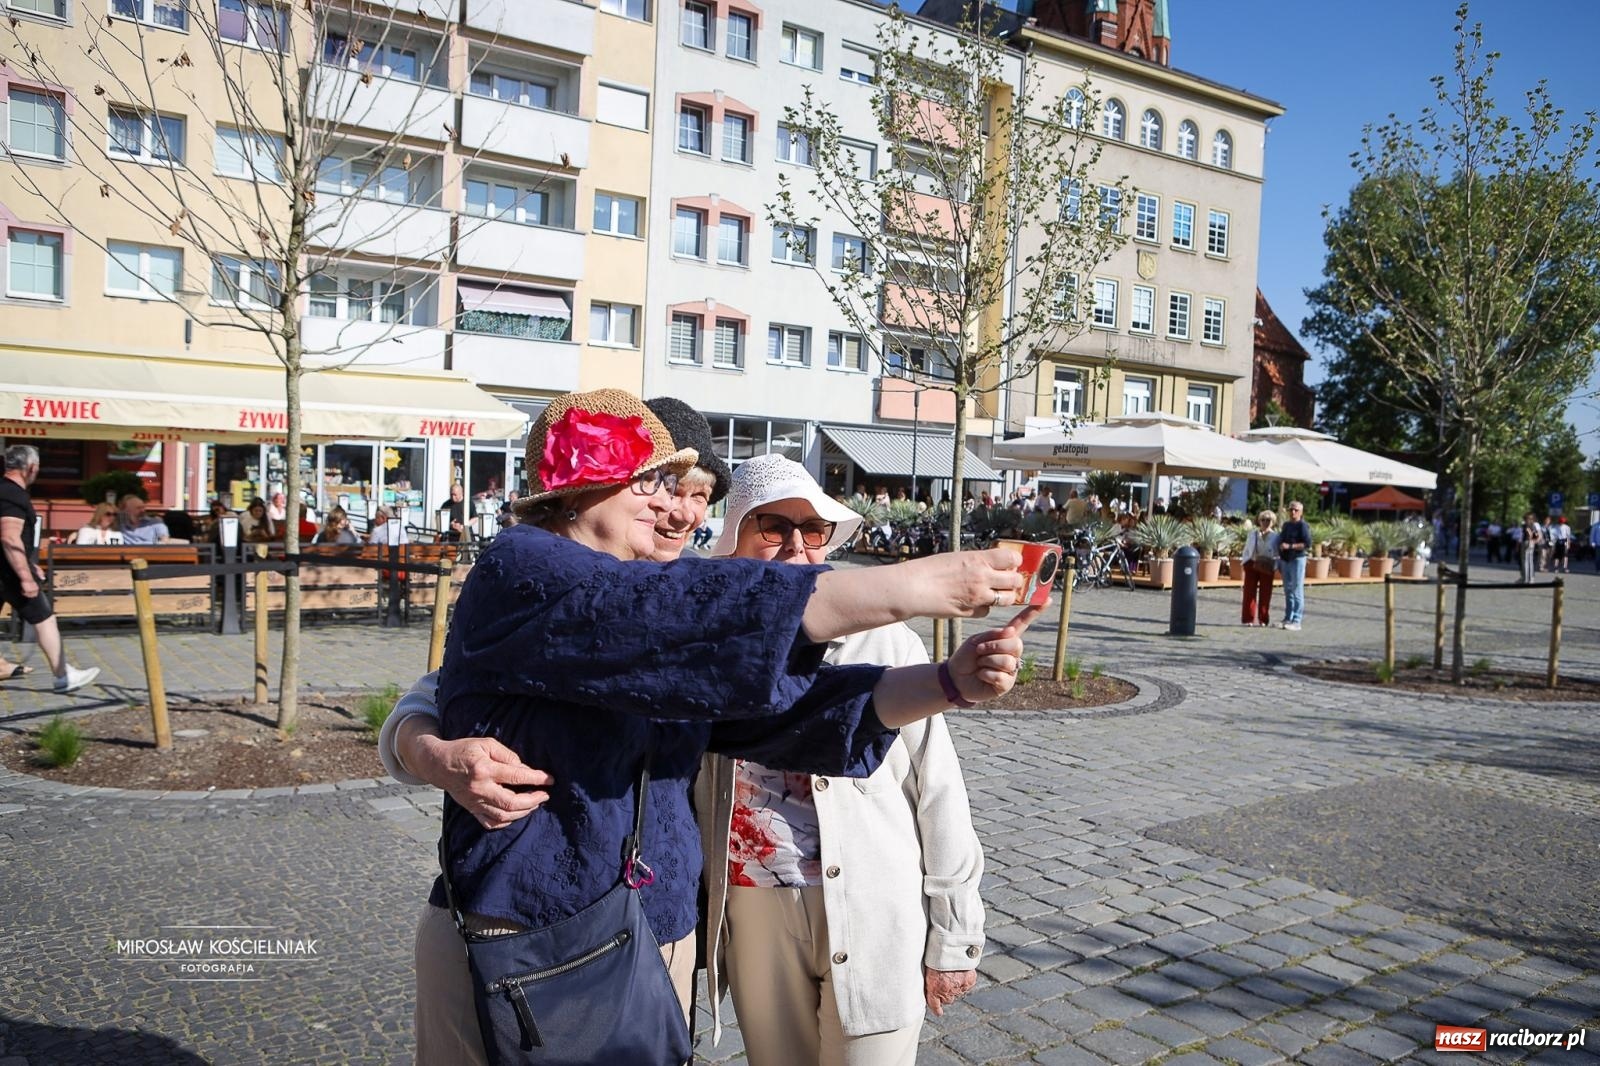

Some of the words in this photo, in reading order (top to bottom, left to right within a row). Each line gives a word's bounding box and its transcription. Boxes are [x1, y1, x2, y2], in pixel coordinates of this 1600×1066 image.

[23, 397, 101, 419] ŻYWIEC
[238, 409, 302, 430] ŻYWI
[418, 419, 476, 437] ŻYWIEC
[1052, 443, 1089, 456] gelatopiu
[1232, 456, 1266, 471] gelatopiu
